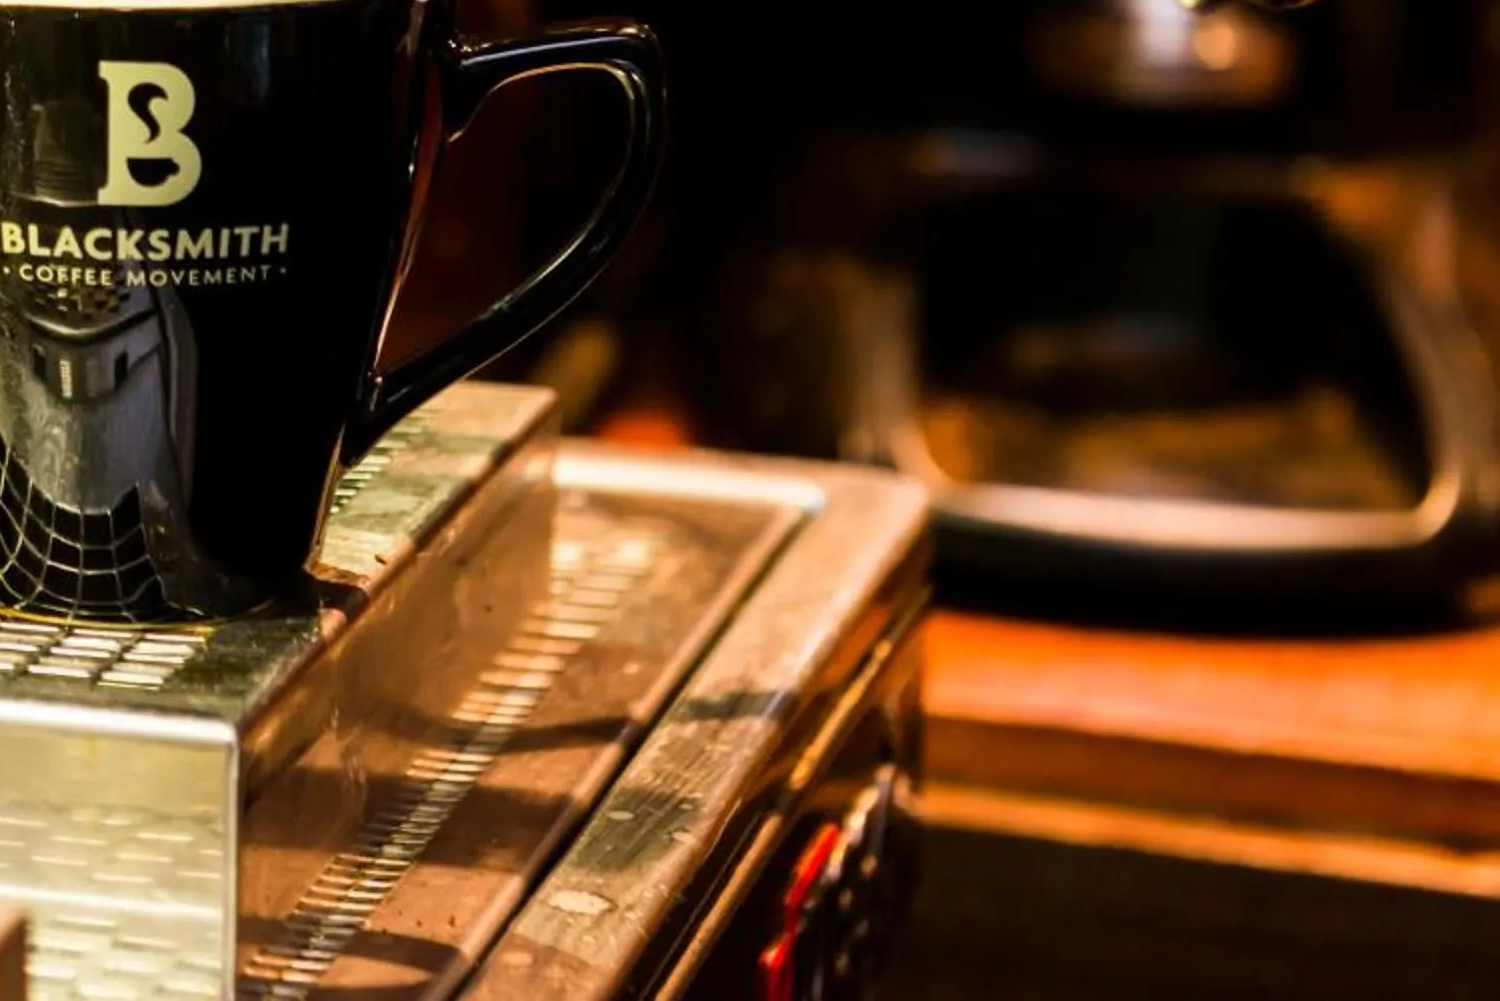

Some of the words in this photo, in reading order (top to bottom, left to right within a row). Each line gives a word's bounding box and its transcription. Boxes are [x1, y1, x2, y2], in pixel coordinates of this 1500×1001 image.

[97, 60, 202, 207] B
[1, 221, 289, 261] BLACKSMITH
[19, 263, 112, 287] COFFEE
[127, 265, 272, 287] MOVEMENT
